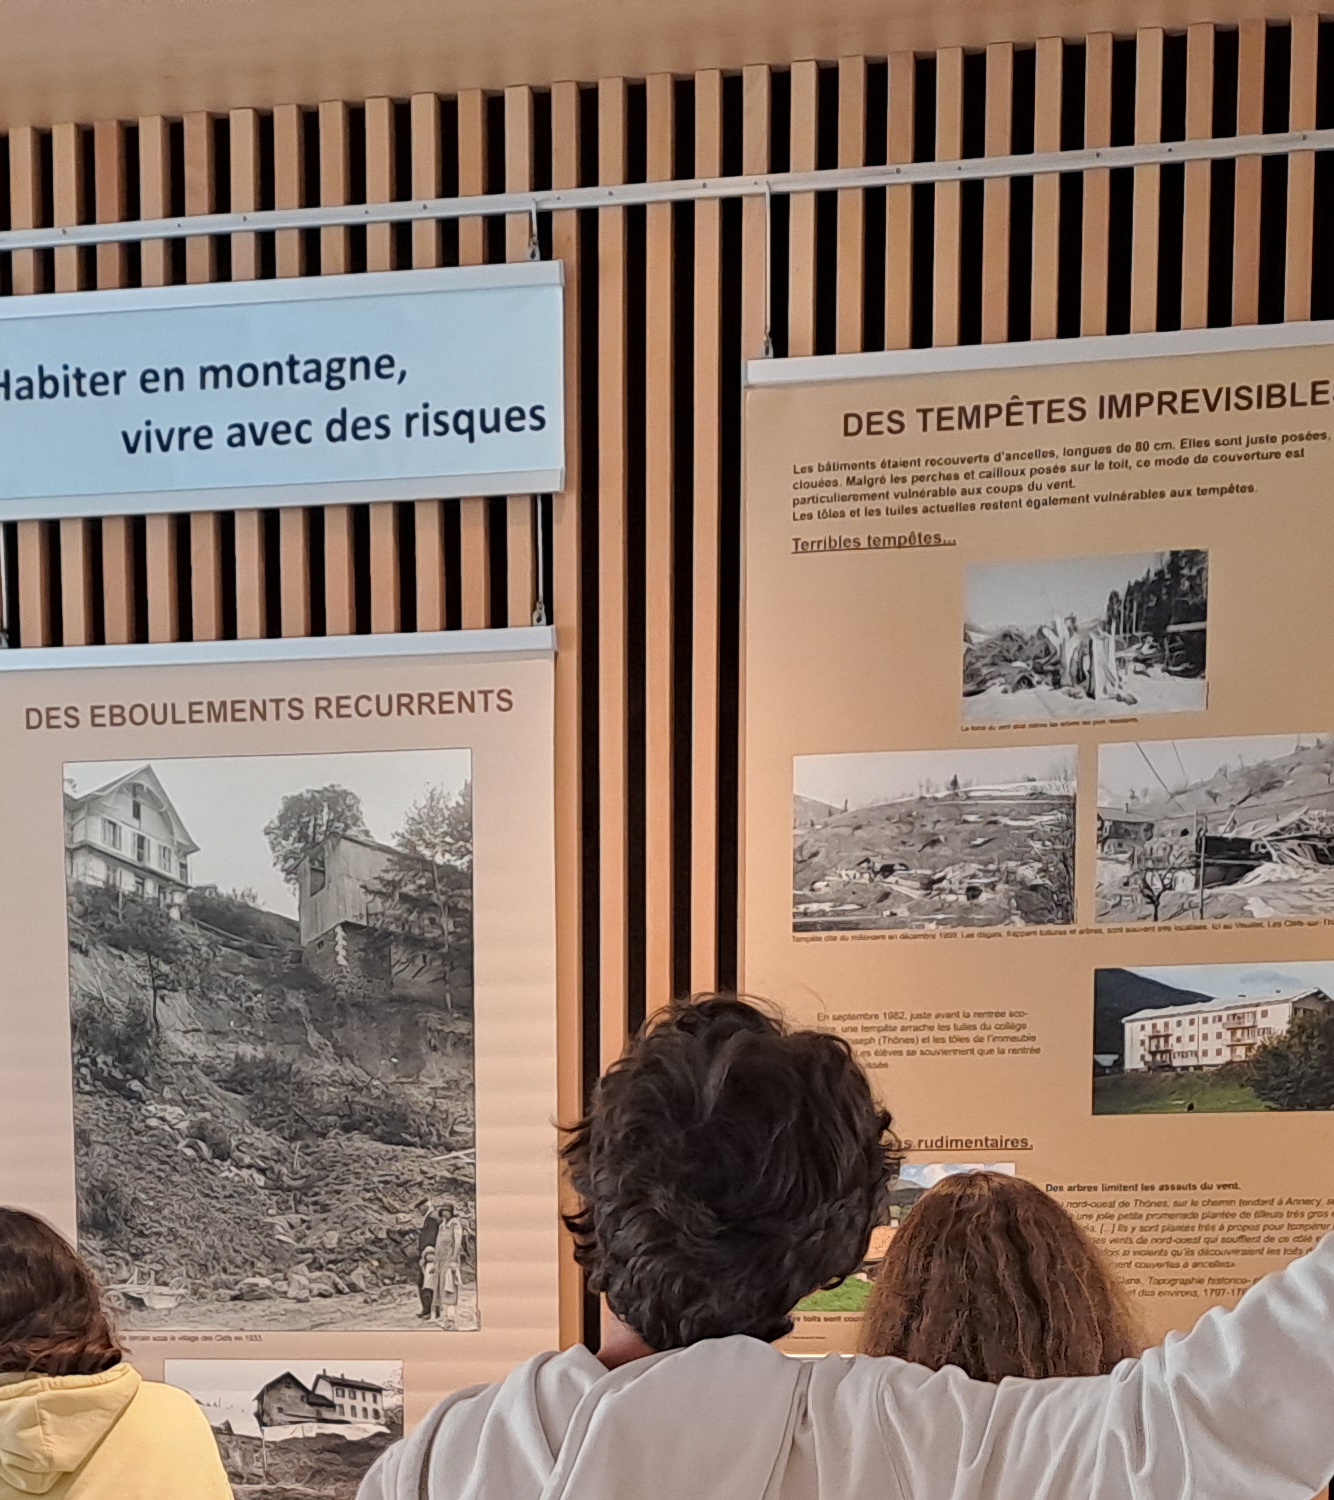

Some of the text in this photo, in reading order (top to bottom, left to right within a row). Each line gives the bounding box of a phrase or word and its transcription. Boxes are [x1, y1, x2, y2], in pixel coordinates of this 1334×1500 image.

[139, 367, 184, 393] en
[199, 354, 406, 389] montagne,
[121, 405, 545, 453] vivre avec des risques
[843, 410, 905, 436] DES
[915, 396, 1086, 431] TEMPÊTES
[793, 464, 813, 474] Les
[792, 535, 861, 552] Terribles
[25, 689, 513, 729] DES EBOULEMENTS RECURRENTS
[918, 1135, 1033, 1150] rudimentaires.
[1045, 1184, 1063, 1192] Des
[1066, 1183, 1097, 1192] arbres
[1101, 1183, 1138, 1191] limitent
[1140, 1183, 1155, 1191] les
[1199, 1181, 1213, 1190] du
[1215, 1182, 1241, 1190] vent.
